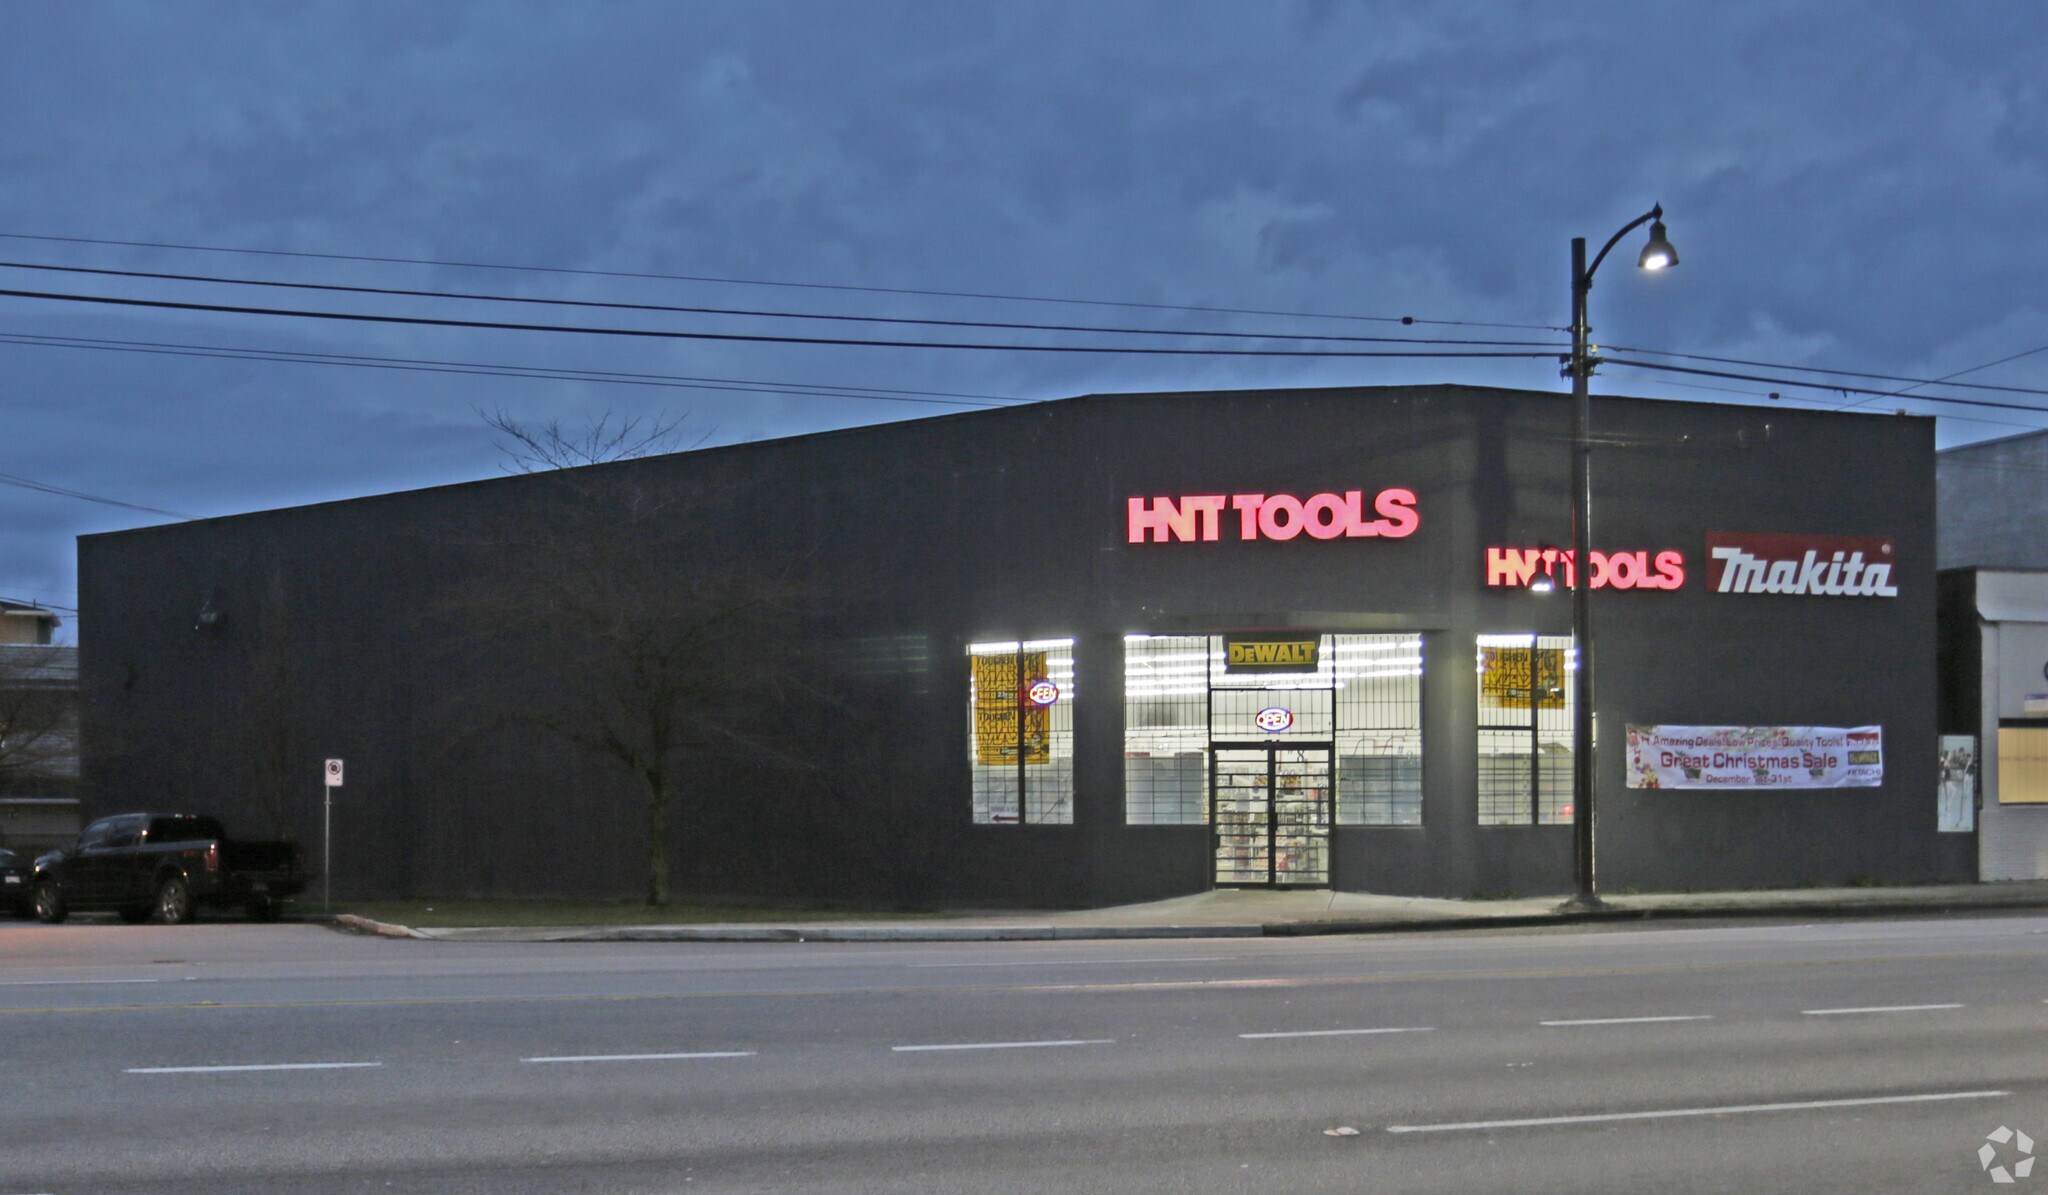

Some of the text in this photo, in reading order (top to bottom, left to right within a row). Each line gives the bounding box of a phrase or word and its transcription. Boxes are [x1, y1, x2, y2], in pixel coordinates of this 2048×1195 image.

[1128, 488, 1420, 543] HNT TOOLS
[1487, 547, 1559, 586] HNT
[1711, 547, 1898, 597] Makita
[1255, 712, 1290, 727] OPEN
[1653, 735, 1694, 749] Amazing
[1726, 736, 1746, 747] Low
[1782, 736, 1814, 750] Quality
[1660, 751, 1838, 769] Great Christmas Sale
[1705, 774, 1750, 784] December
